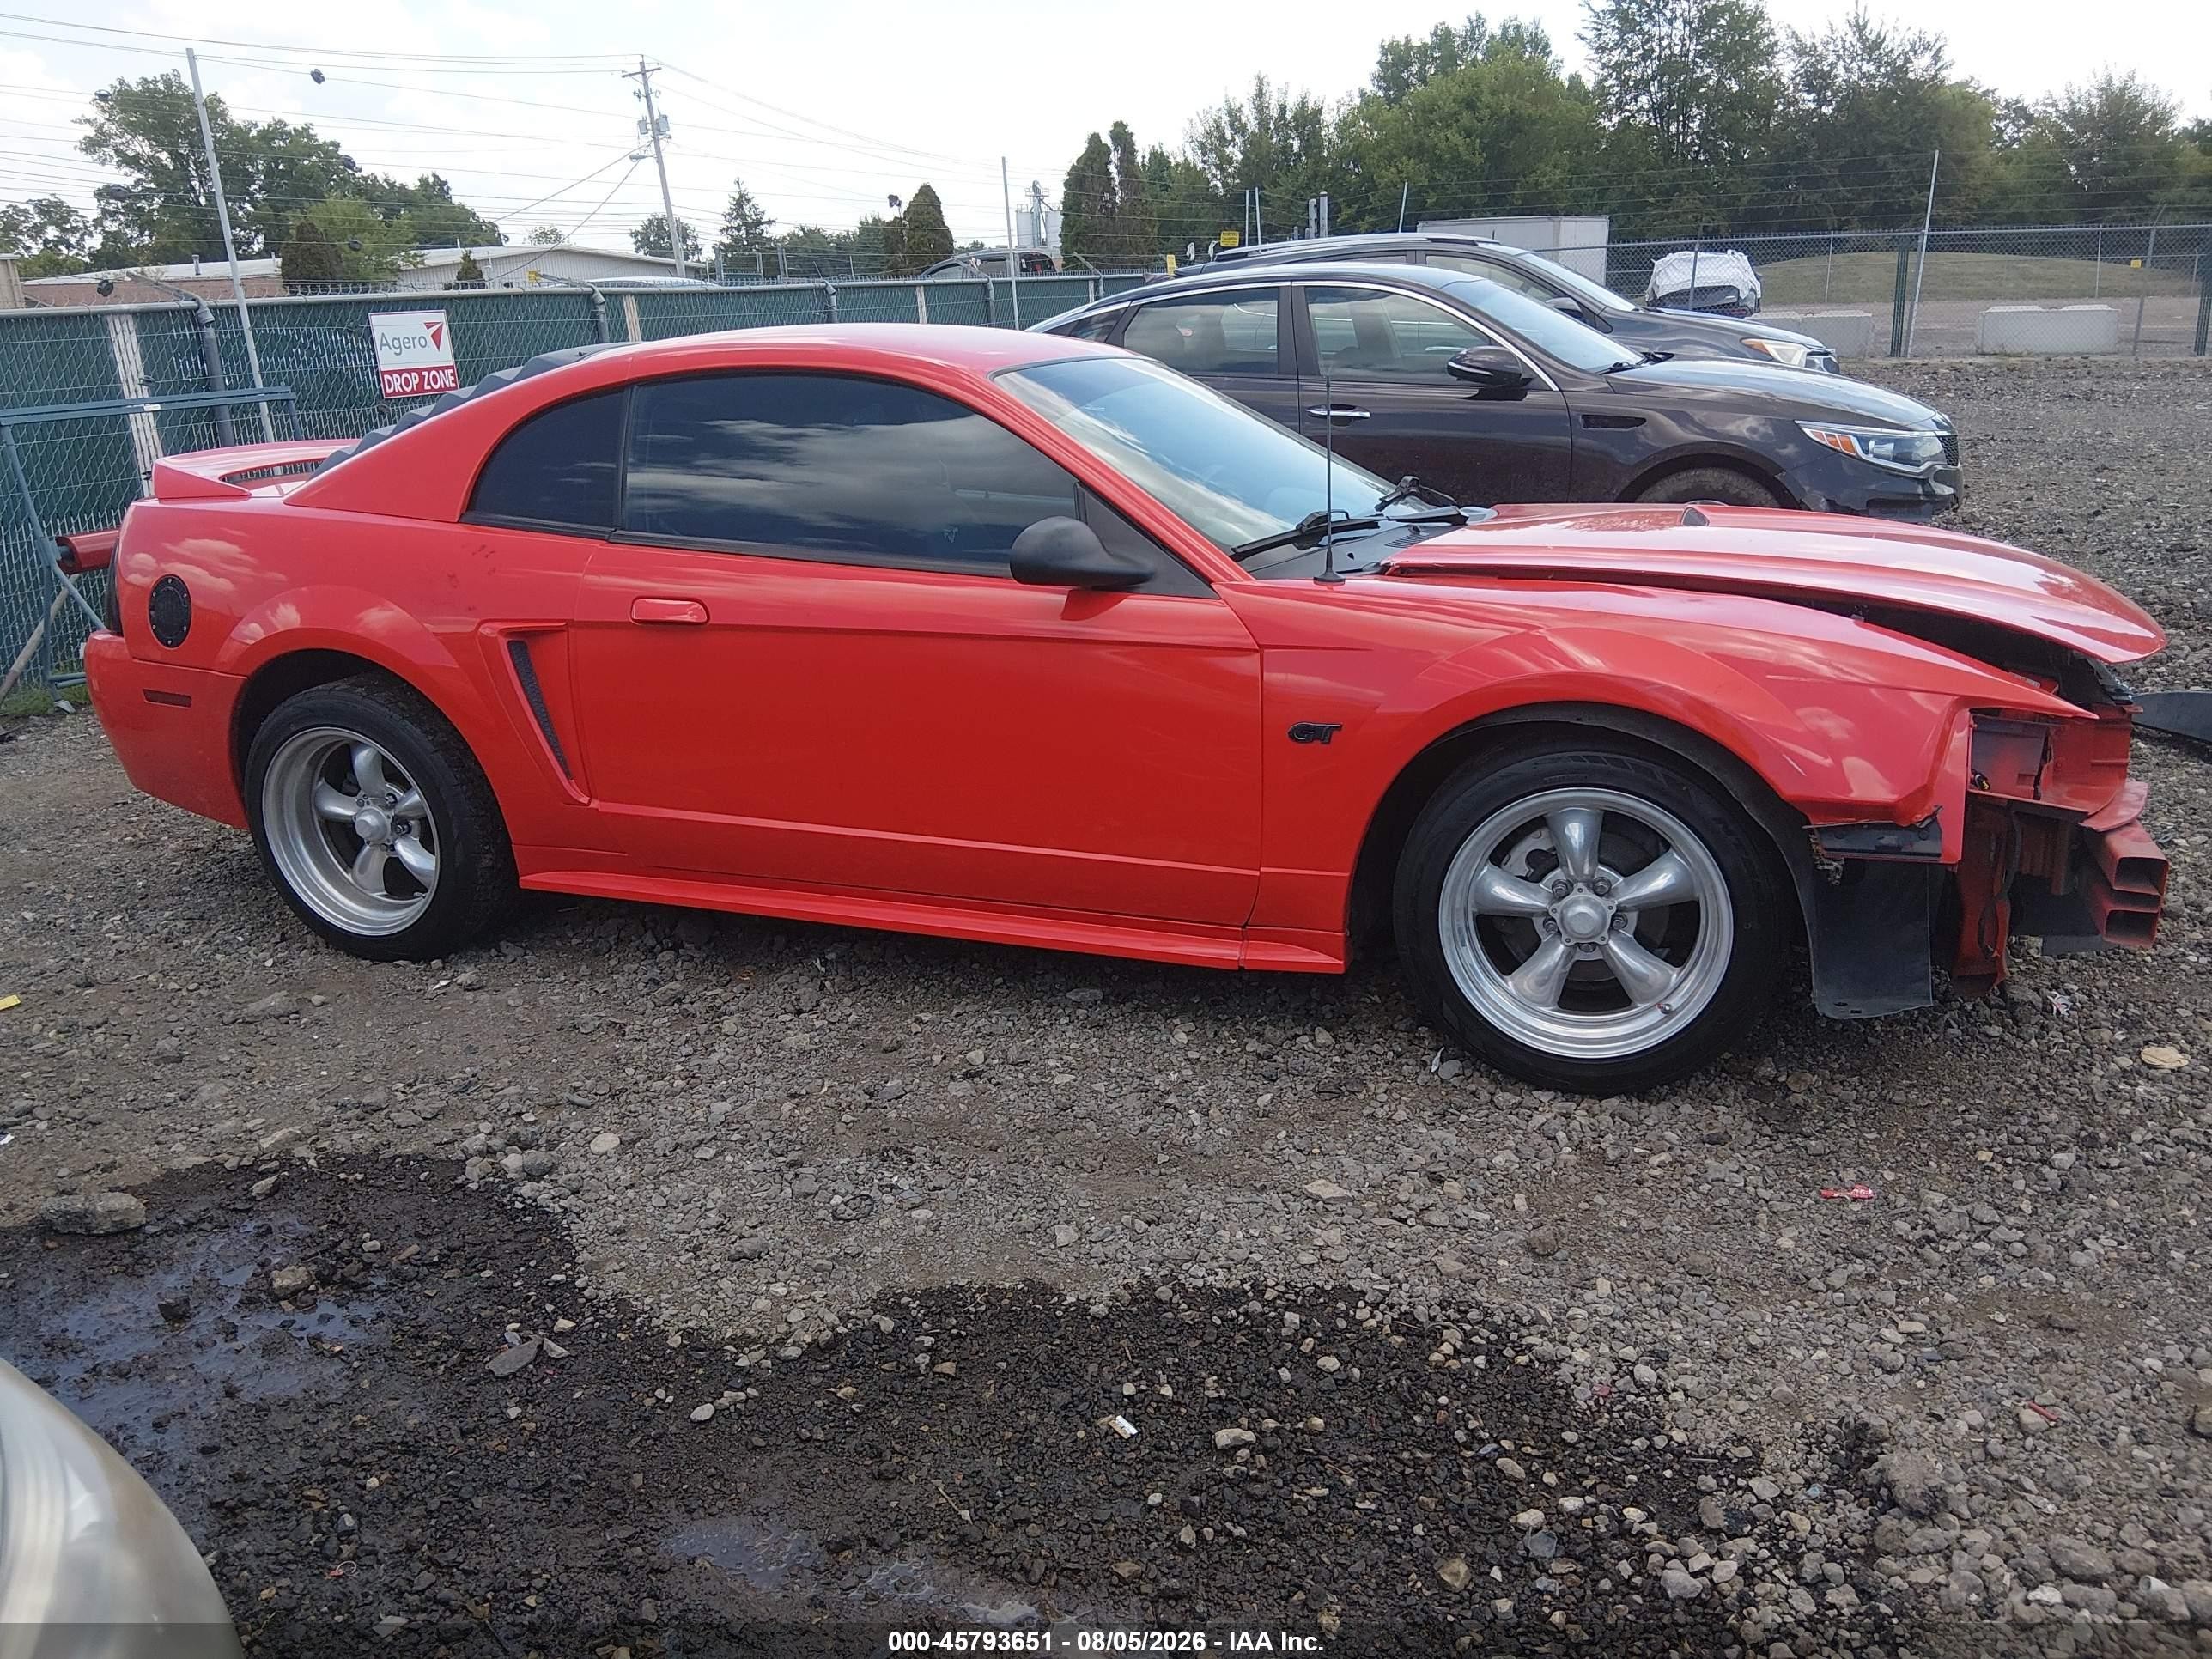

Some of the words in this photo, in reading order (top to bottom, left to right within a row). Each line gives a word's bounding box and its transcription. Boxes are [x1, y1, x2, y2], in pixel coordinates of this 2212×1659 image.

[380, 332, 428, 356] Agero
[383, 372, 420, 394] DROP
[421, 368, 457, 390] ZONE
[1287, 721, 1343, 744] GT
